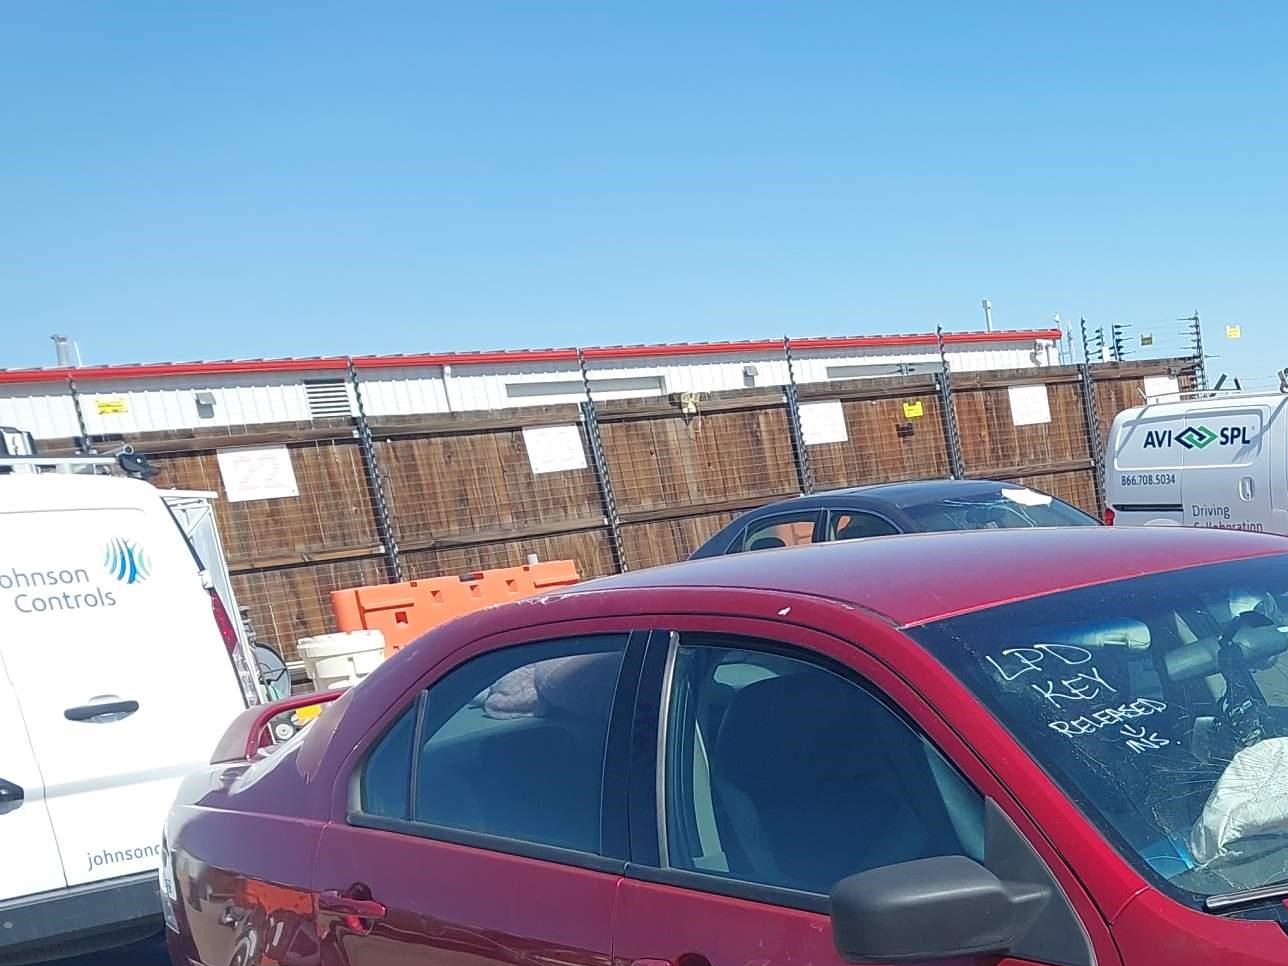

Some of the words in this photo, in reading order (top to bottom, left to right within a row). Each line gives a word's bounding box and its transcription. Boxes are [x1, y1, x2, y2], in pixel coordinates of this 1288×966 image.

[1143, 430, 1172, 448] AVI
[1219, 426, 1251, 446] SPL
[1121, 474, 1176, 486] 866.708.5034
[1192, 504, 1231, 519] Driving
[0, 567, 90, 589] ohnson
[14, 586, 117, 613] Controls
[985, 643, 1092, 681] LPD
[1031, 667, 1118, 708] KEY
[1048, 698, 1167, 738] RELEASED
